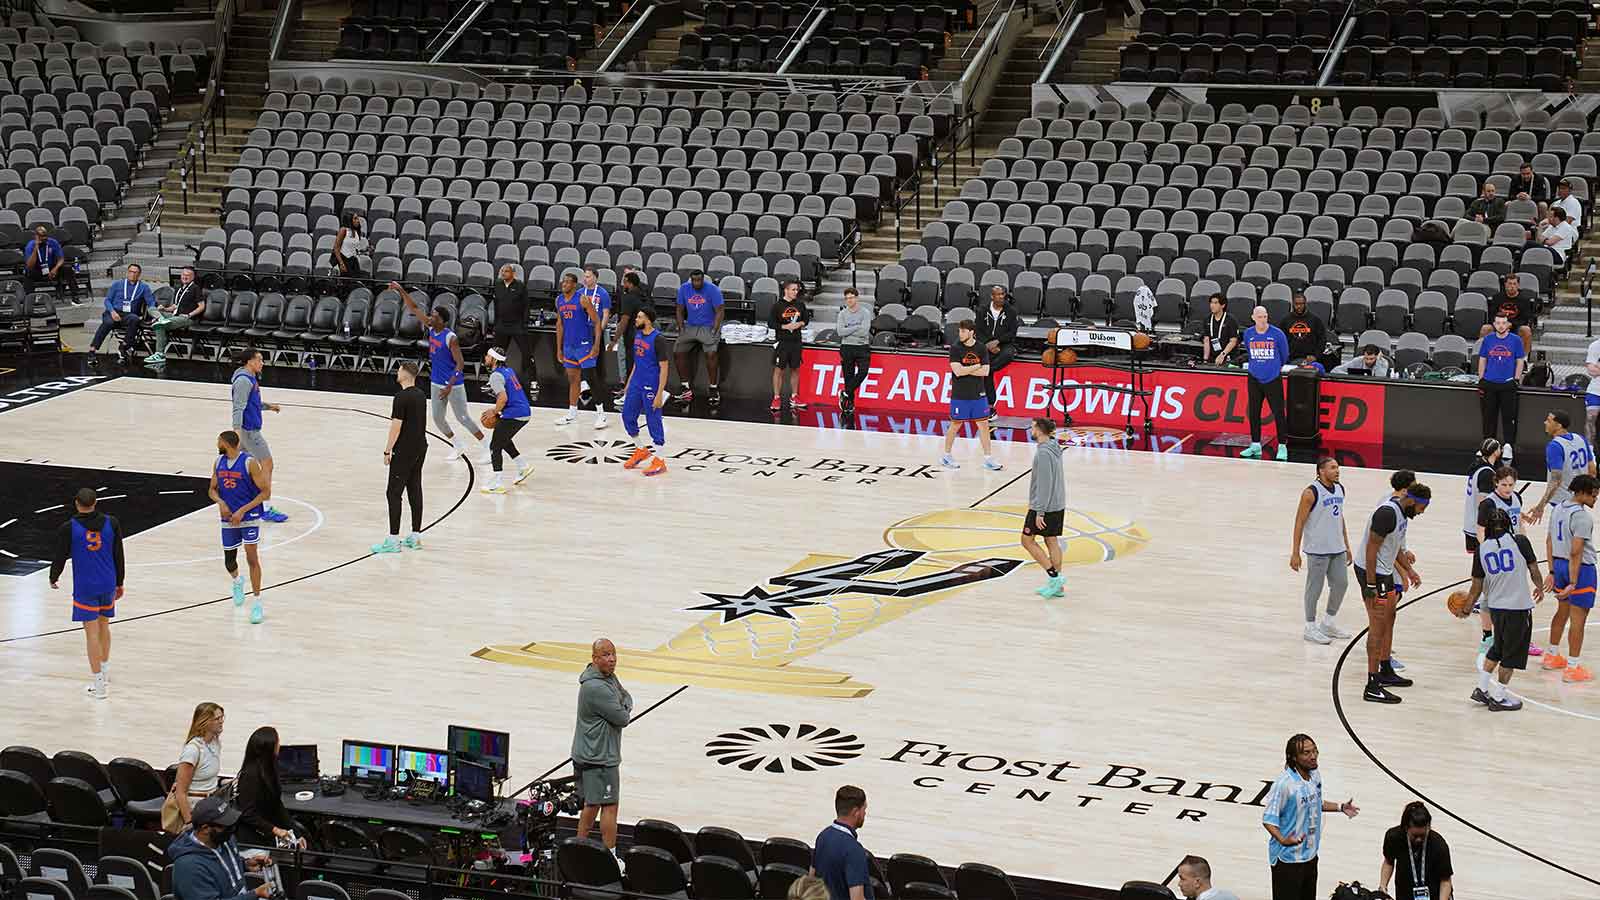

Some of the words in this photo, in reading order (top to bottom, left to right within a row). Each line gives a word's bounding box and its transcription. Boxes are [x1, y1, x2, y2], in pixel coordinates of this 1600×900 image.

[1311, 98, 1321, 114] 8
[1089, 332, 1116, 341] Wilson
[0, 375, 107, 409] LTRA
[886, 369, 1014, 408] AREA
[1025, 377, 1142, 417] BOWL
[1150, 385, 1186, 419] IS
[1193, 386, 1368, 431] CLED
[668, 447, 801, 468] Frost
[804, 457, 944, 479] Bank
[1569, 448, 1587, 469] 20
[223, 478, 237, 489] 25
[684, 464, 878, 485] CENTER
[1332, 504, 1340, 517] 2
[86, 530, 102, 551] 9
[1484, 549, 1515, 575] 00
[880, 739, 1080, 782] Frost
[912, 776, 1208, 822] CENTER
